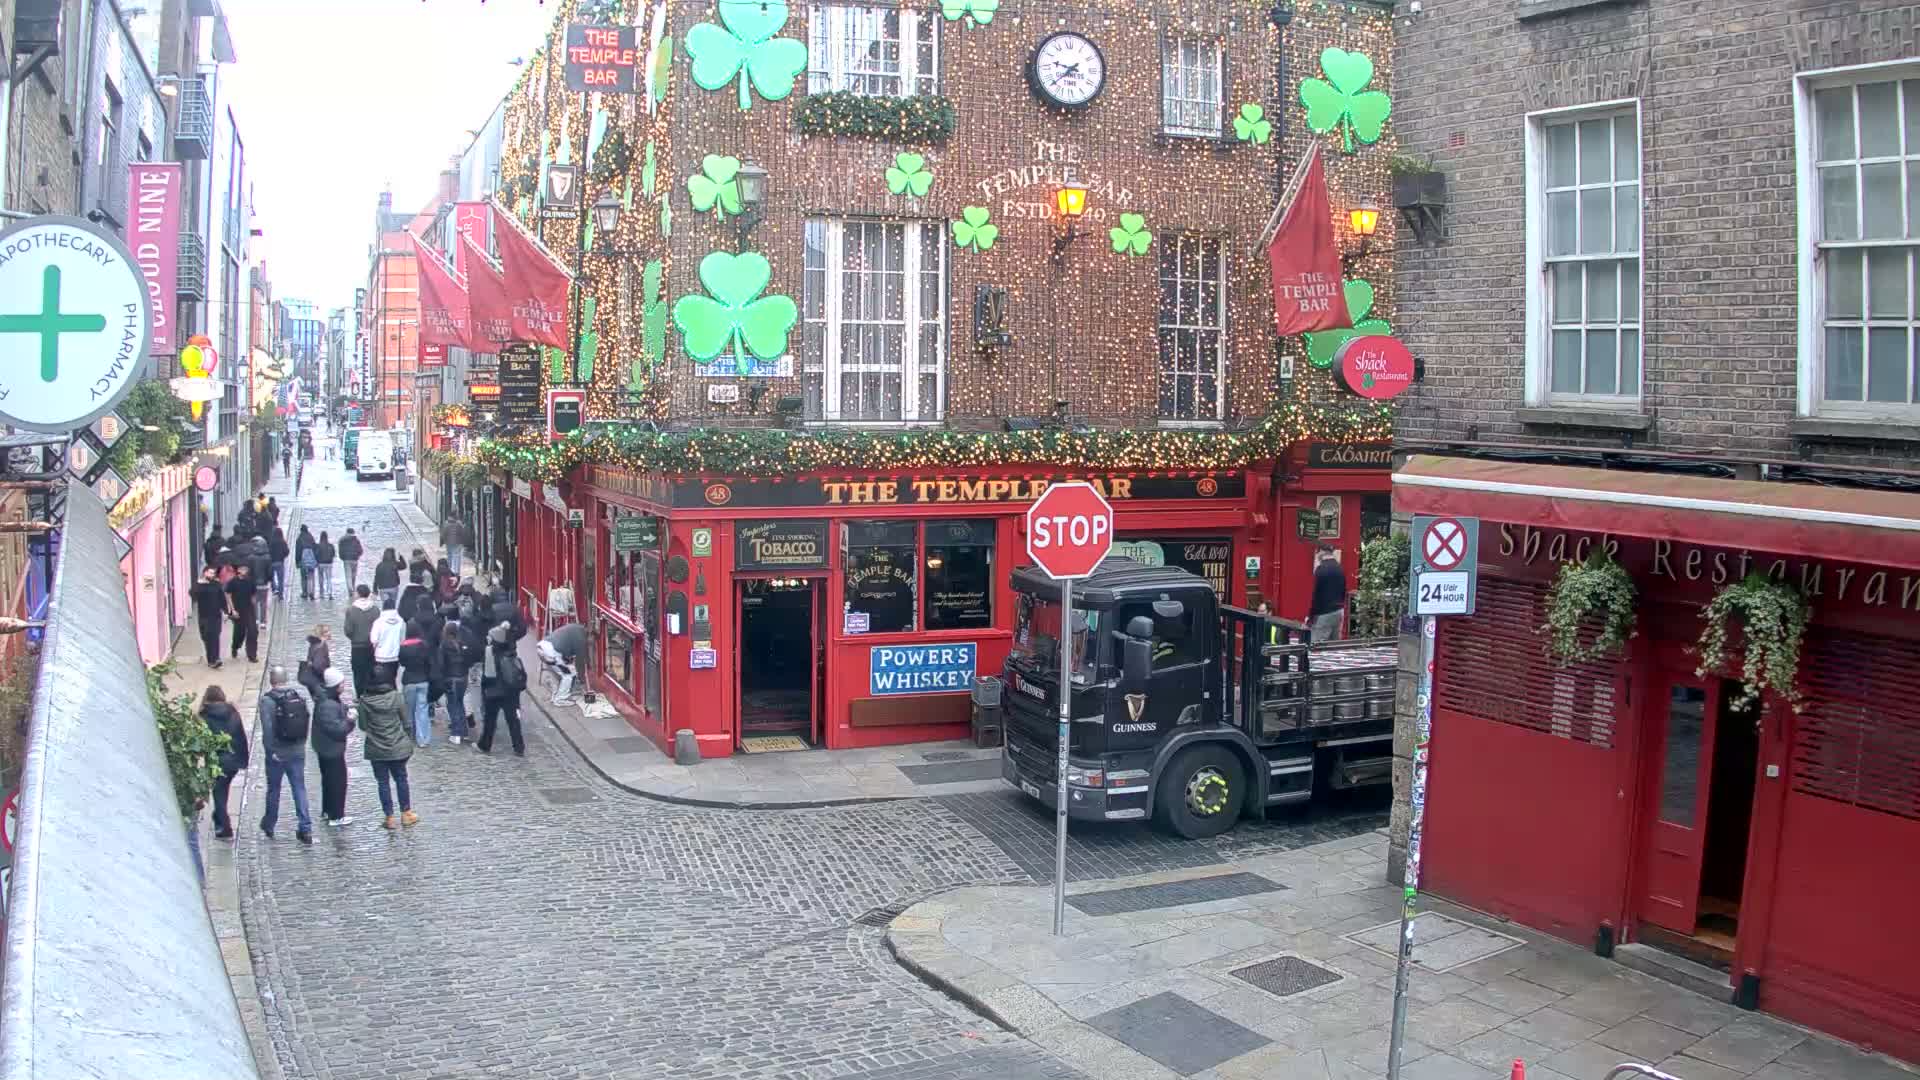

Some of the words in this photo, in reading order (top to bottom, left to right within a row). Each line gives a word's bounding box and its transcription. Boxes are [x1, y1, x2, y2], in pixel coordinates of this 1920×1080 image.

[584, 29, 619, 46] THE
[568, 47, 634, 65] TEMPLE
[584, 69, 617, 86] BAR
[1056, 72, 1085, 80] GUINNESS
[1032, 140, 1081, 163] THE
[976, 162, 1078, 202] TEMPLE
[138, 172, 170, 232] NINE
[542, 210, 576, 219] GUINNESS
[1299, 272, 1324, 283] THE
[1280, 283, 1337, 300] TEMPLE
[512, 305, 563, 323] TEMPLE
[1299, 298, 1330, 313] BAR
[527, 319, 552, 334] BAR
[89, 303, 136, 402] PHARMACY
[500, 353, 540, 362] TEMPLE
[1354, 349, 1387, 372] Shack
[1367, 351, 1376, 359] The
[510, 362, 531, 371] BAR
[1372, 372, 1408, 381] Restaurant
[713, 488, 726, 500] 48
[824, 480, 898, 504] THE
[912, 478, 1050, 504] TEMPLE
[1066, 478, 1134, 499] AR
[1200, 482, 1213, 493] 48
[742, 522, 776, 539] Importers
[1033, 514, 1108, 549] STOP
[749, 538, 816, 562] TOBACCO
[1122, 546, 1145, 558] THE
[1499, 522, 1620, 566] Shack
[1208, 546, 1228, 560] 1840
[848, 565, 892, 589] TEMPLE
[894, 568, 914, 588] BAR
[1202, 562, 1226, 578] THE
[1420, 584, 1442, 602] 24
[1442, 584, 1460, 592] Uair
[1443, 593, 1465, 602] HOUR
[879, 647, 970, 668] POWER'S
[873, 670, 973, 690] WHISKEY
[1020, 680, 1046, 700] GUINNESS
[1112, 722, 1157, 734] GUINNESS
